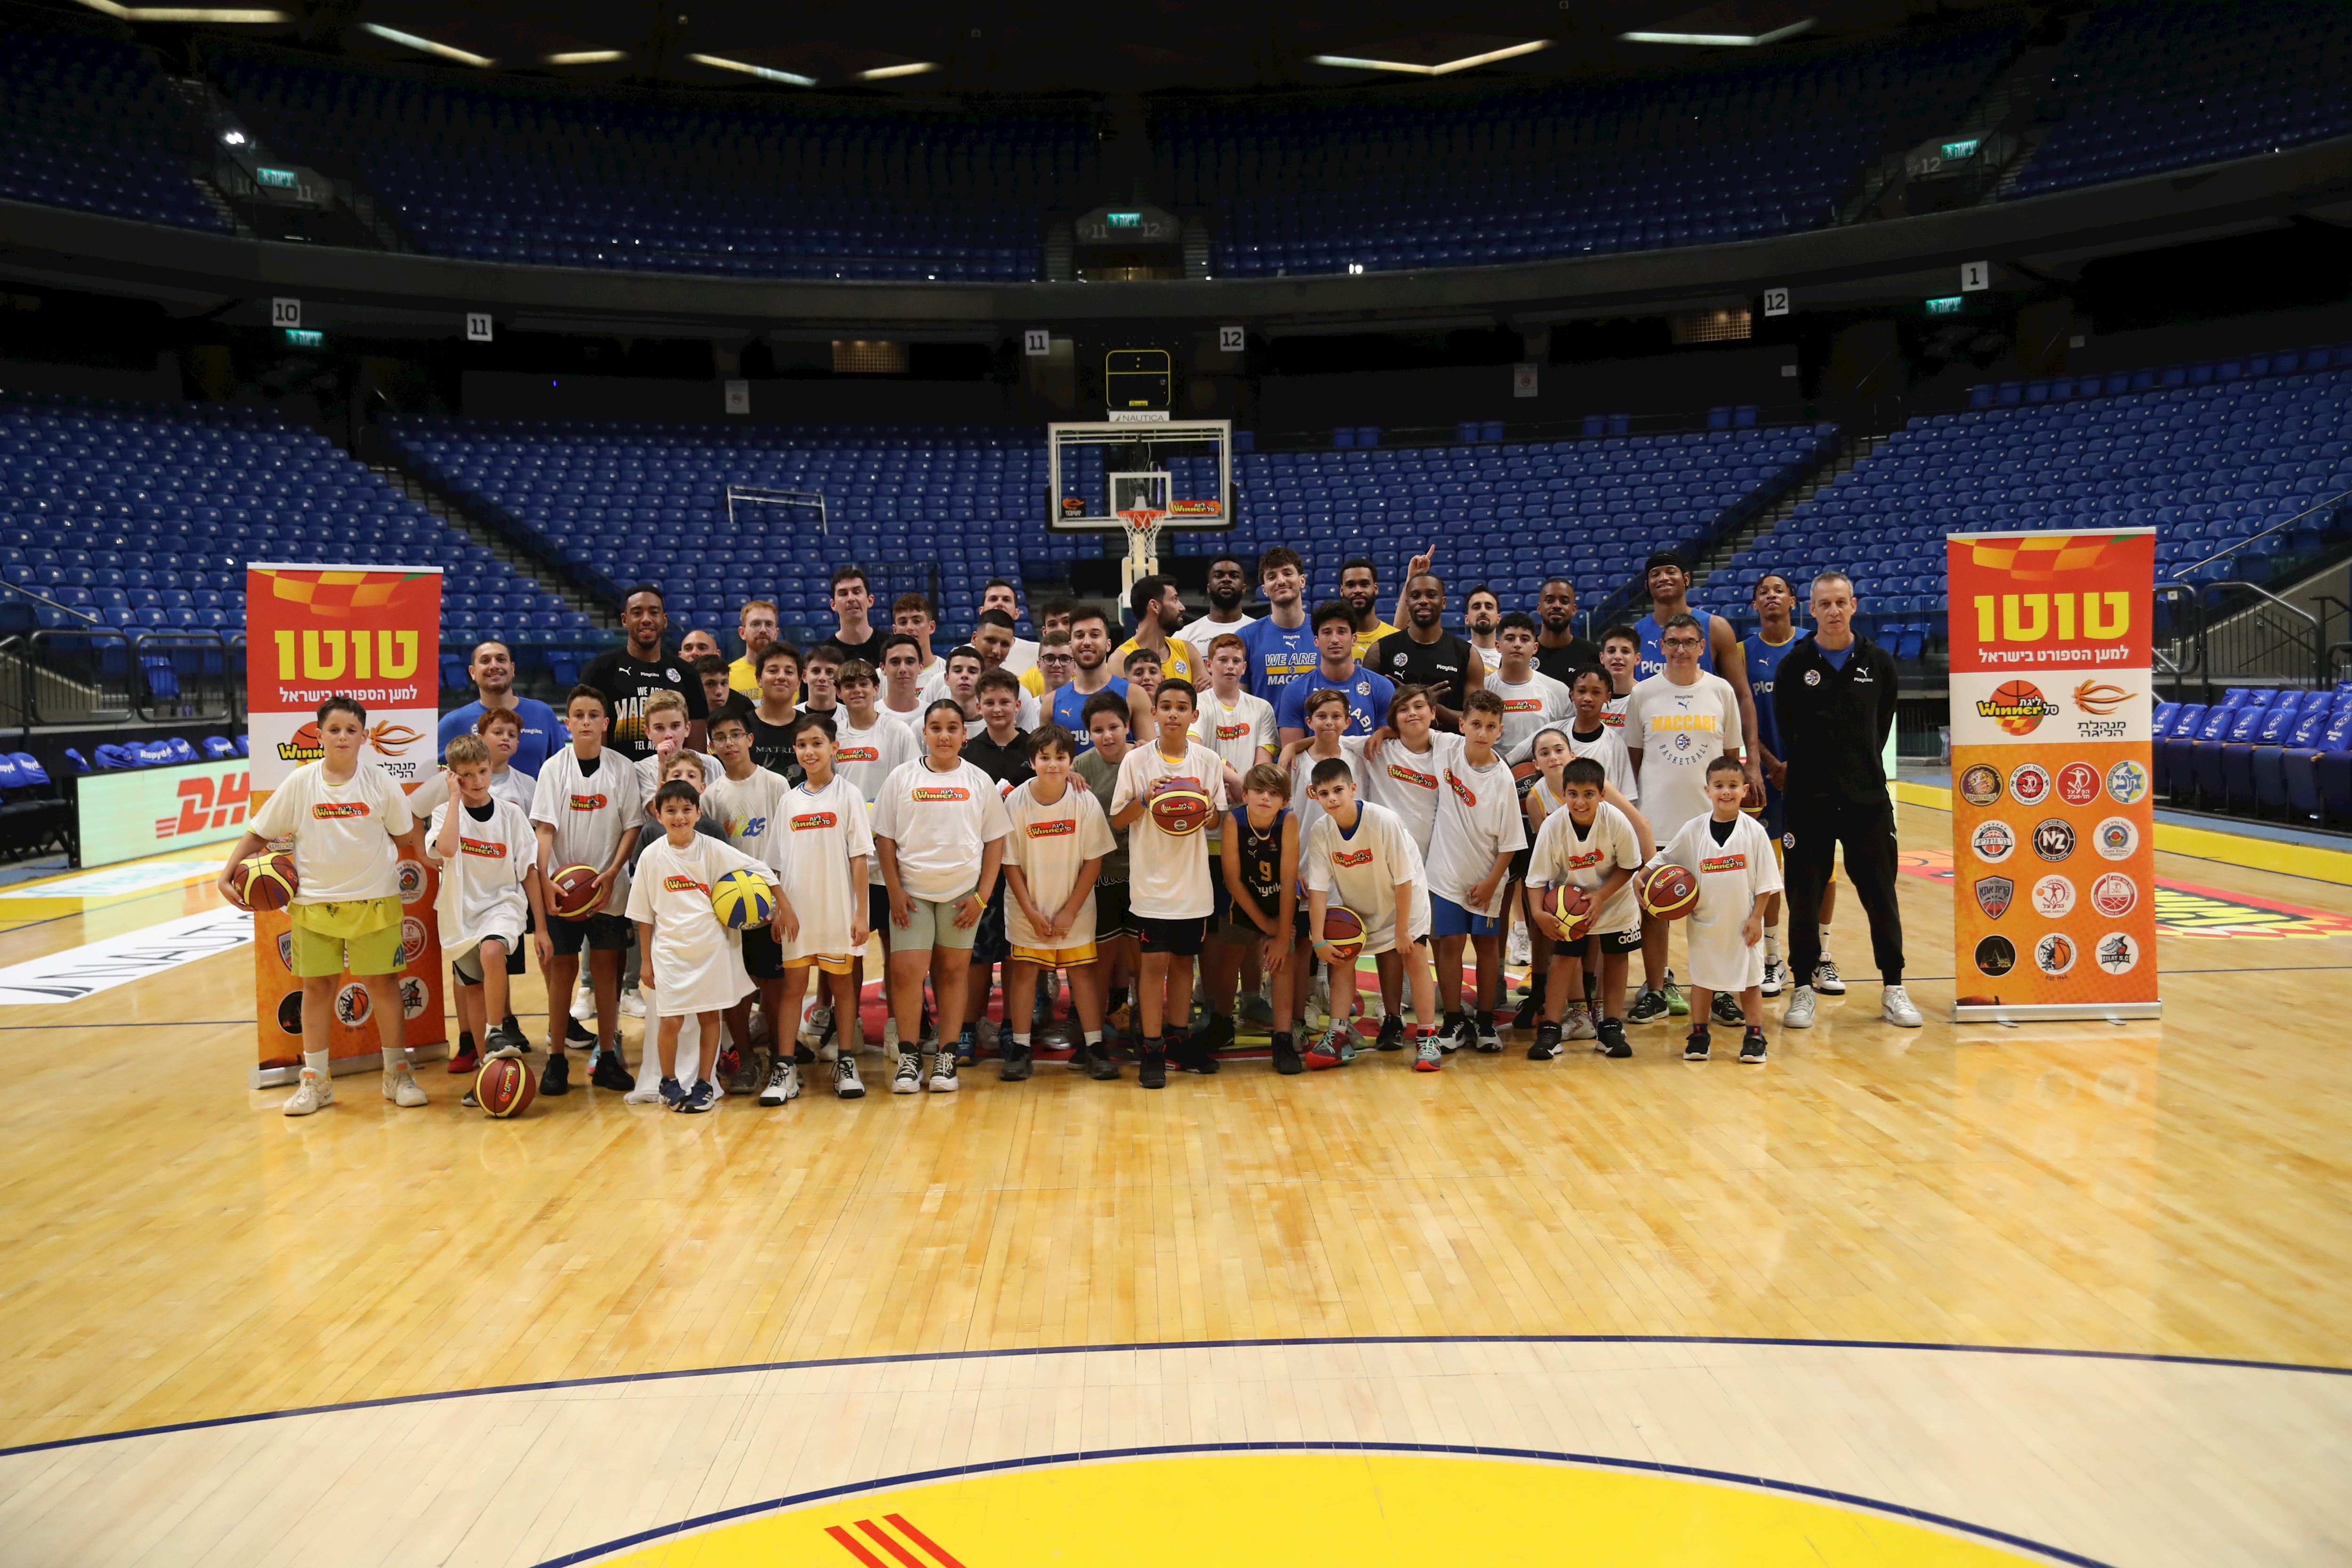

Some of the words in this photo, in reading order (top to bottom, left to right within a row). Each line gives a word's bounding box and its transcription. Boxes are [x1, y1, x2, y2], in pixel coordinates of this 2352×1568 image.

[1955, 140, 1977, 157] יציאה
[1921, 156, 1941, 174] 12
[296, 184, 313, 202] 11
[1120, 213, 1139, 226] יציאה
[1091, 224, 1107, 238] 11
[1142, 223, 1160, 237] 12
[1970, 268, 1979, 285] 1
[1766, 294, 1786, 311] 12
[1939, 297, 1961, 313] יציאה
[276, 303, 297, 322] 10
[471, 319, 488, 335] 11
[1028, 334, 1045, 350] 11
[1223, 331, 1241, 347] 12
[1174, 504, 1206, 512] Winner
[1974, 591, 2130, 642] טוטו
[275, 630, 418, 680] טוטו
[1265, 653, 1287, 666] WE
[1288, 653, 1317, 665] ARE
[1979, 649, 2034, 663] בישראל
[2037, 649, 2091, 661] הספורט
[2095, 645, 2129, 663] למען
[279, 687, 332, 702] בישראל
[389, 685, 418, 703] למען
[637, 687, 648, 696] WE
[1978, 701, 2042, 716] Winner
[2043, 703, 2058, 715] סל
[2019, 696, 2042, 707] ליגת
[1652, 714, 1716, 732] MACCABI
[2078, 721, 2126, 730] מנהלת
[2081, 728, 2123, 738] הליגה
[277, 742, 325, 761] Winn
[635, 740, 645, 750] TEL
[140, 748, 168, 761] Rapyd
[837, 752, 864, 761] Winner
[1659, 743, 1708, 765] BASKETBALL
[1391, 768, 1424, 784] Winner
[2013, 765, 2031, 778] ירושלים
[917, 790, 954, 799] Winner
[316, 808, 353, 817] Winner
[1031, 827, 1064, 836] Winner
[2043, 831, 2066, 850] NZ
[1569, 859, 1596, 868] Winner
[1703, 861, 1735, 871] Winner
[1259, 860, 1272, 882] 9
[1659, 873, 1676, 885] Winner
[1979, 886, 1995, 899] אתא
[1995, 886, 2010, 899] קרית
